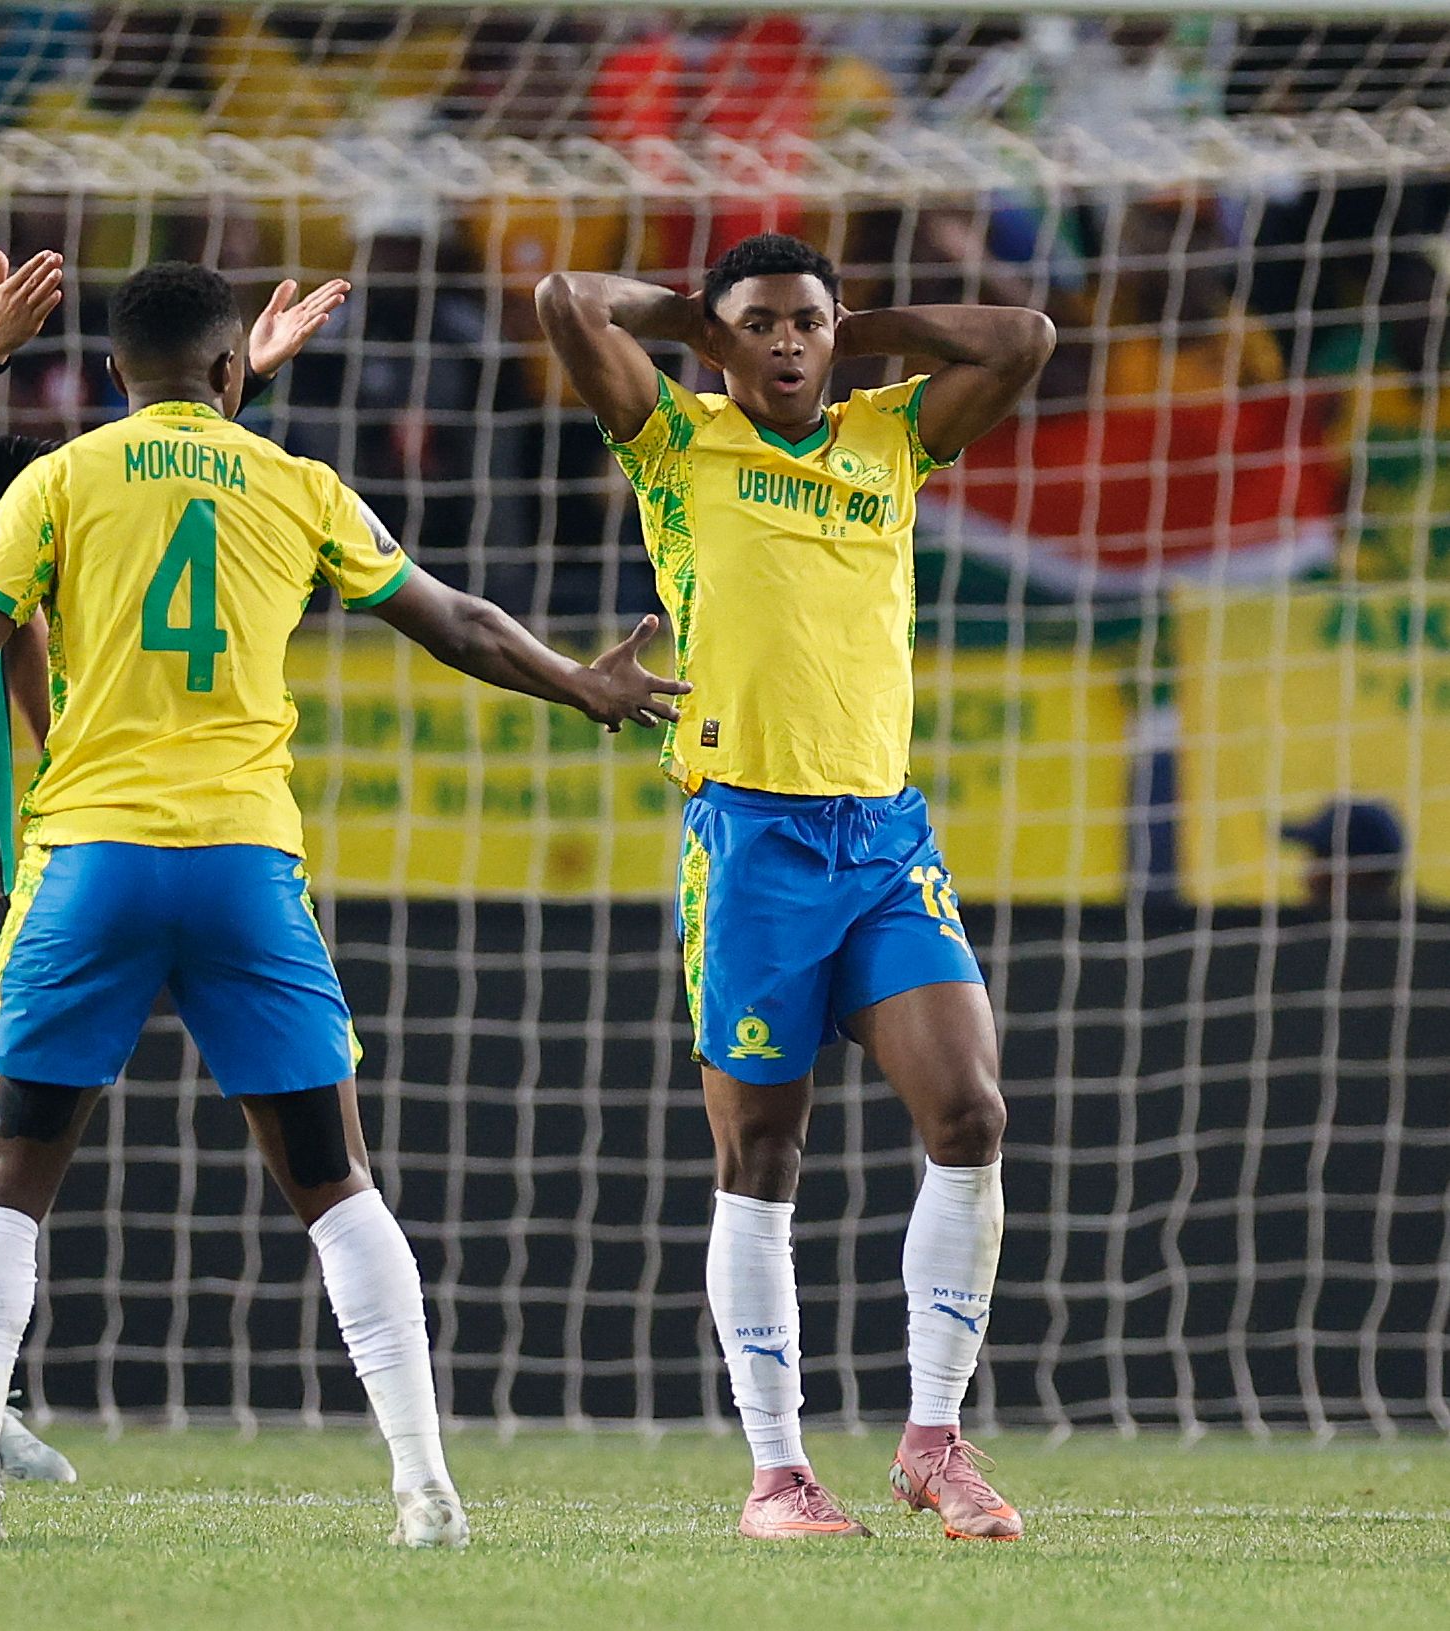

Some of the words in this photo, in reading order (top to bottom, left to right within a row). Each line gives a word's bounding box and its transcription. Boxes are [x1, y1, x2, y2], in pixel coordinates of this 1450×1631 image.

[124, 440, 247, 494] MOKOENA
[738, 467, 832, 518] UBUNTU
[141, 498, 227, 692] 4
[932, 1286, 988, 1303] MSFC
[736, 1325, 788, 1338] MSFC
